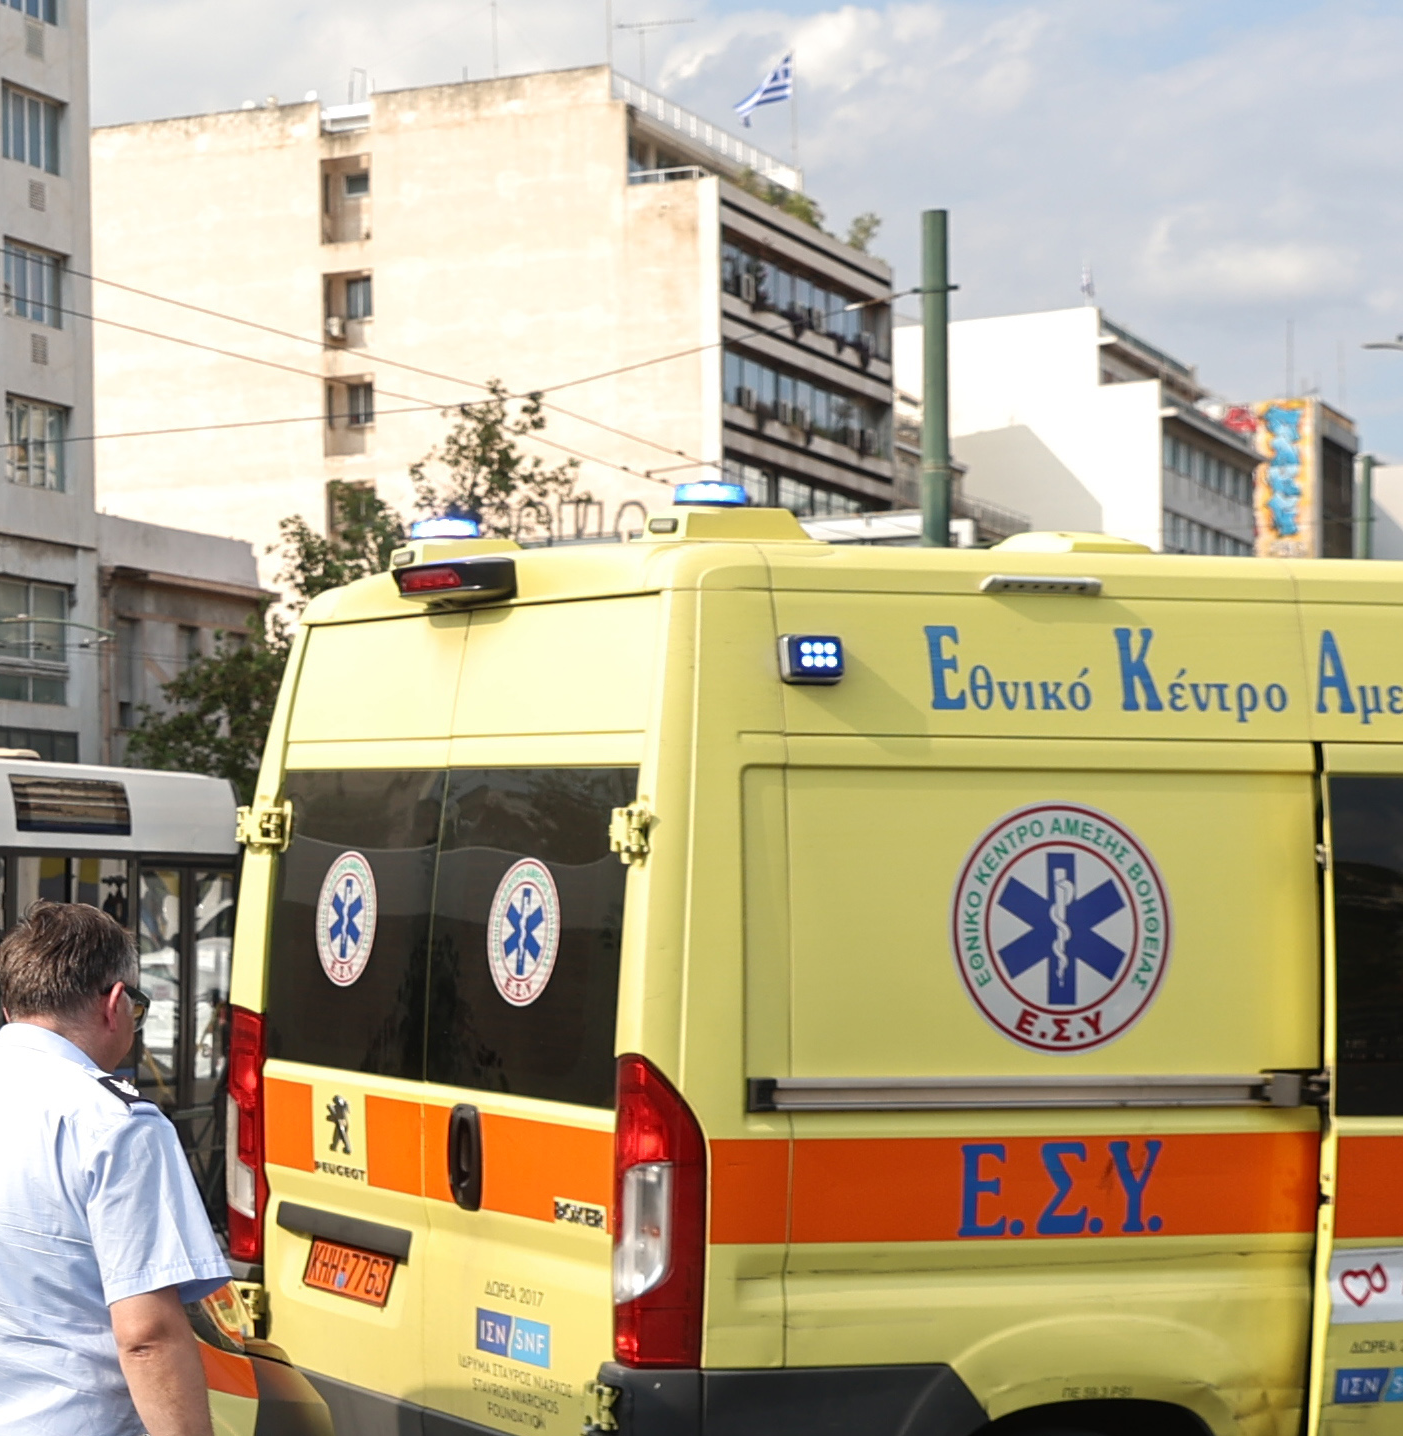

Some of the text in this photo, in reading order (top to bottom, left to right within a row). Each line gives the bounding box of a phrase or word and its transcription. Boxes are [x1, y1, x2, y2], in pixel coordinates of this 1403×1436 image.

[923, 625, 1092, 711] Εθνικό
[1114, 627, 1288, 722] Κέντρο
[963, 817, 1161, 990] ΕΘΝΙΚΟ ΚΕΝΤΡΟ ΑΜΕΣΗΣ ΒΟΗΘΕΙΑΣ
[314, 1160, 365, 1182] PEUGEOT
[957, 1139, 1163, 1238] Ε.Σ.Υ.
[519, 1286, 545, 1307] 2017
[480, 1319, 506, 1345] ΙΣΝ
[514, 1328, 545, 1355] SNF
[1340, 1376, 1381, 1396] ΙΣΝ
